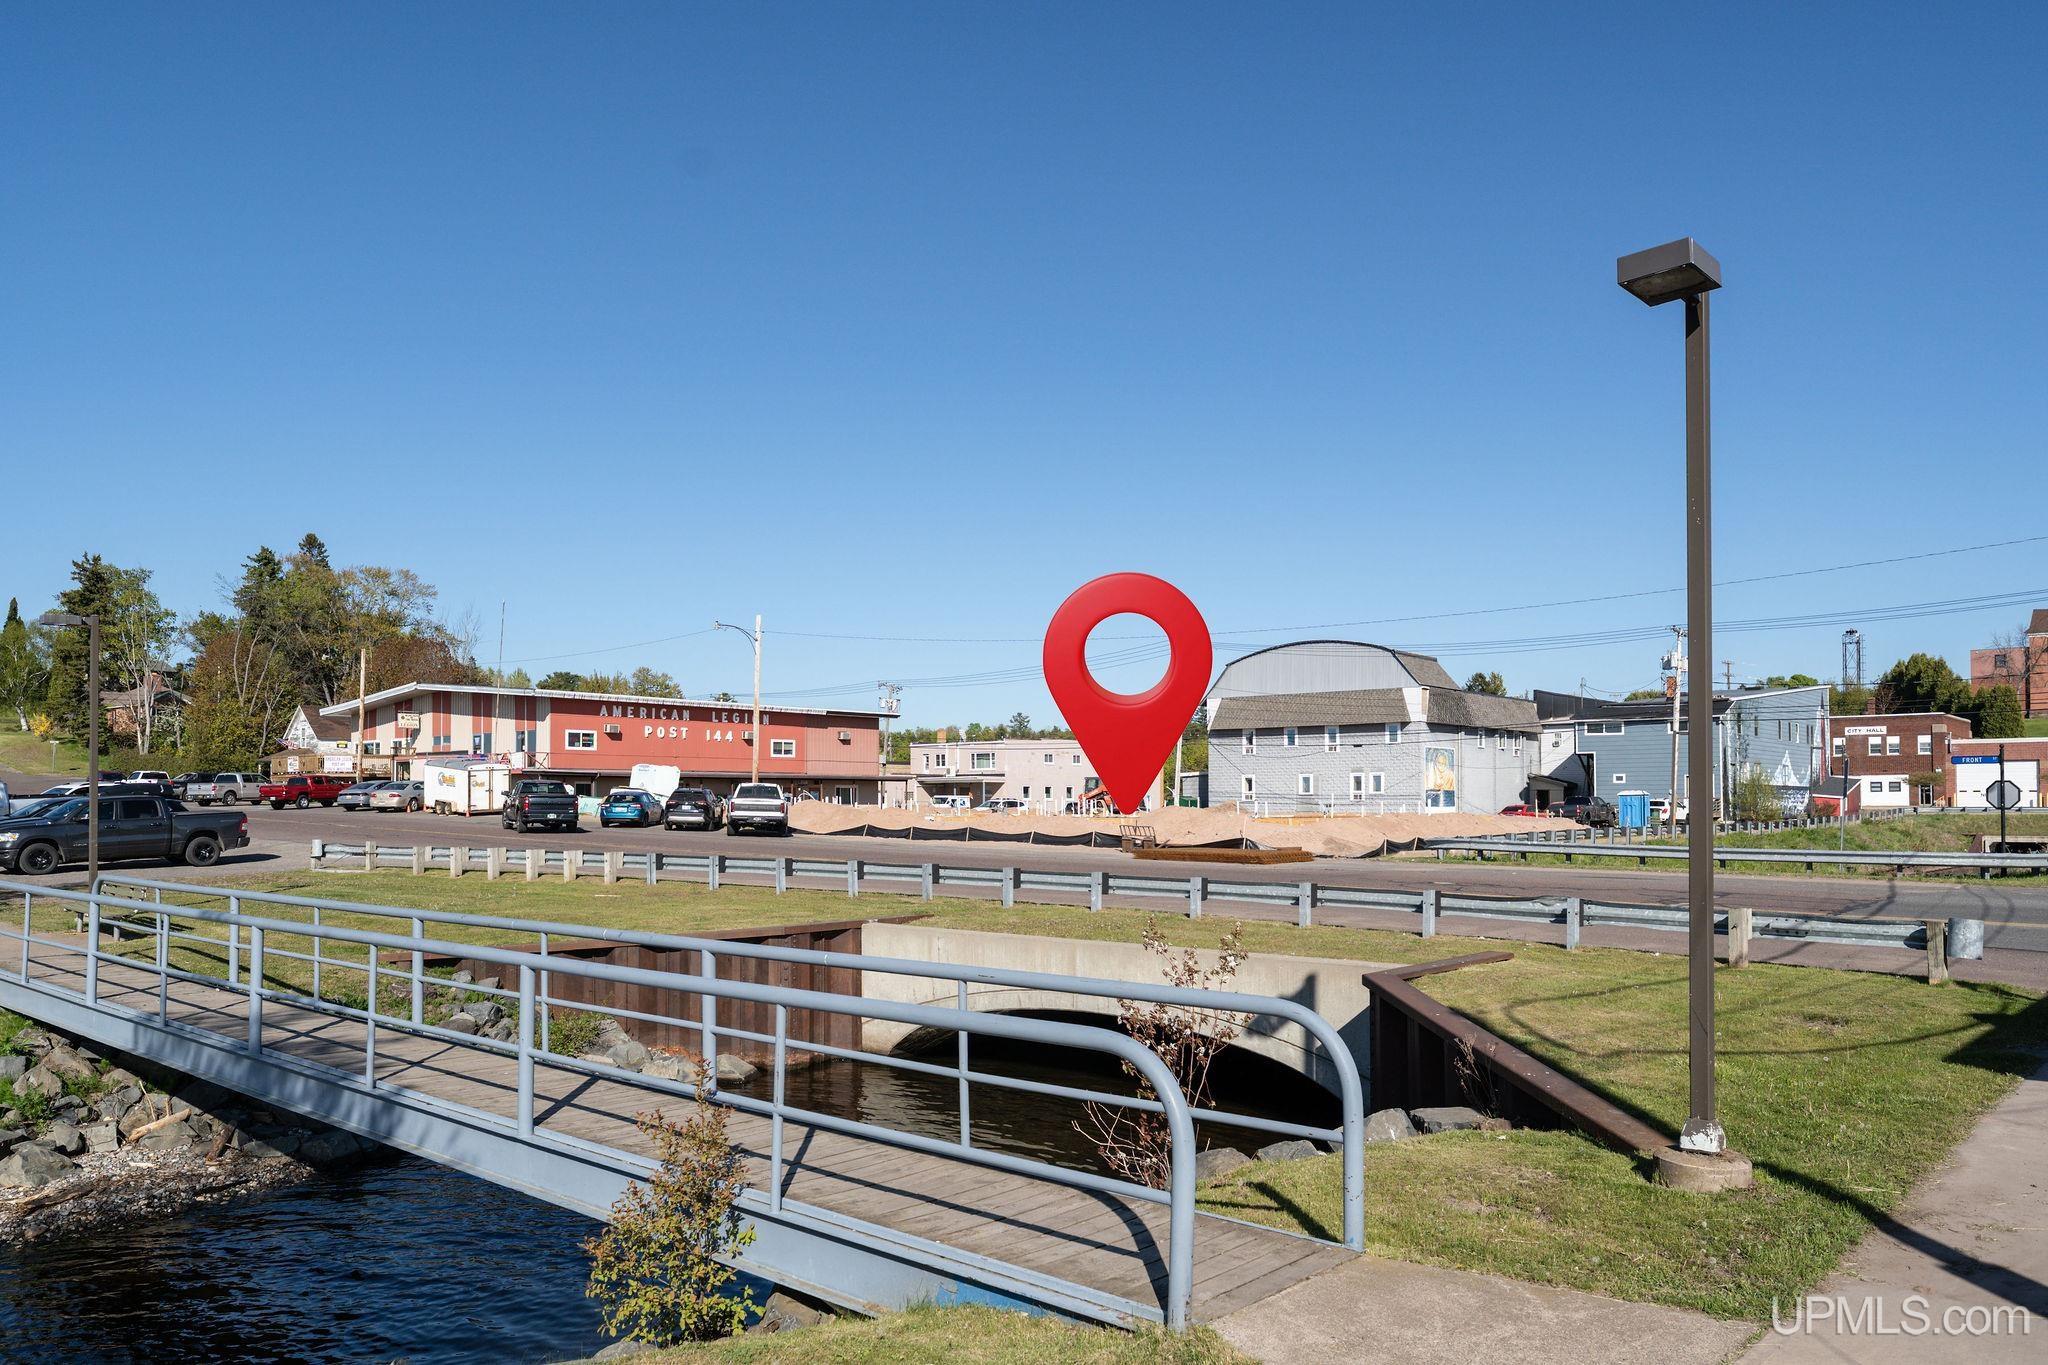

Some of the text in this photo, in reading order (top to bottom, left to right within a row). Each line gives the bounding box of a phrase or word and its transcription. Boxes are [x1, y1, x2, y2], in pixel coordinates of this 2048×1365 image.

[600, 705, 690, 721] AMERICAN
[644, 725, 734, 742] POST 144
